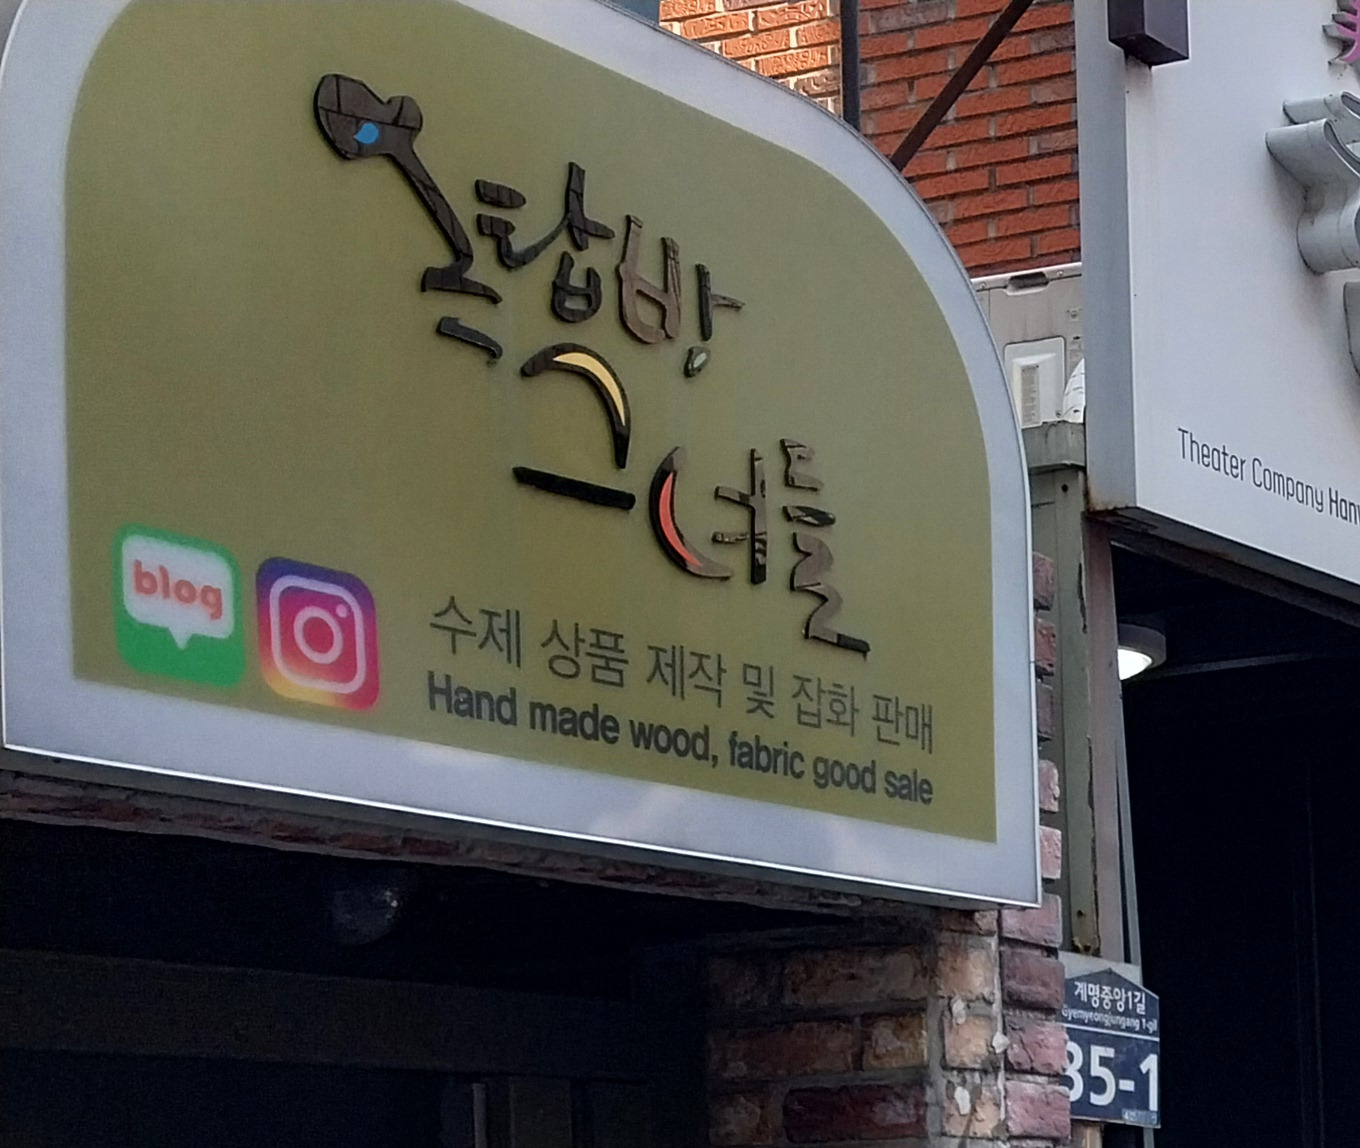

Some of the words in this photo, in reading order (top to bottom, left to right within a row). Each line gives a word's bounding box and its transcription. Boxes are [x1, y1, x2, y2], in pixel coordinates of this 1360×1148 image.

[512, 343, 870, 658] 그녀들
[1177, 427, 1246, 482] Theater
[1252, 458, 1324, 513] Company
[131, 559, 224, 621] blog
[427, 673, 518, 727] Hand
[528, 697, 619, 746] made
[629, 719, 719, 768] wood,
[727, 730, 806, 781] fabric
[812, 749, 877, 796] good
[883, 766, 935, 806] sale
[429, 598, 522, 669] 수제
[541, 620, 629, 688] 상품
[646, 641, 727, 710] 제작
[740, 665, 776, 721] 및
[791, 673, 860, 740] 잡화
[871, 692, 935, 757] 판매
